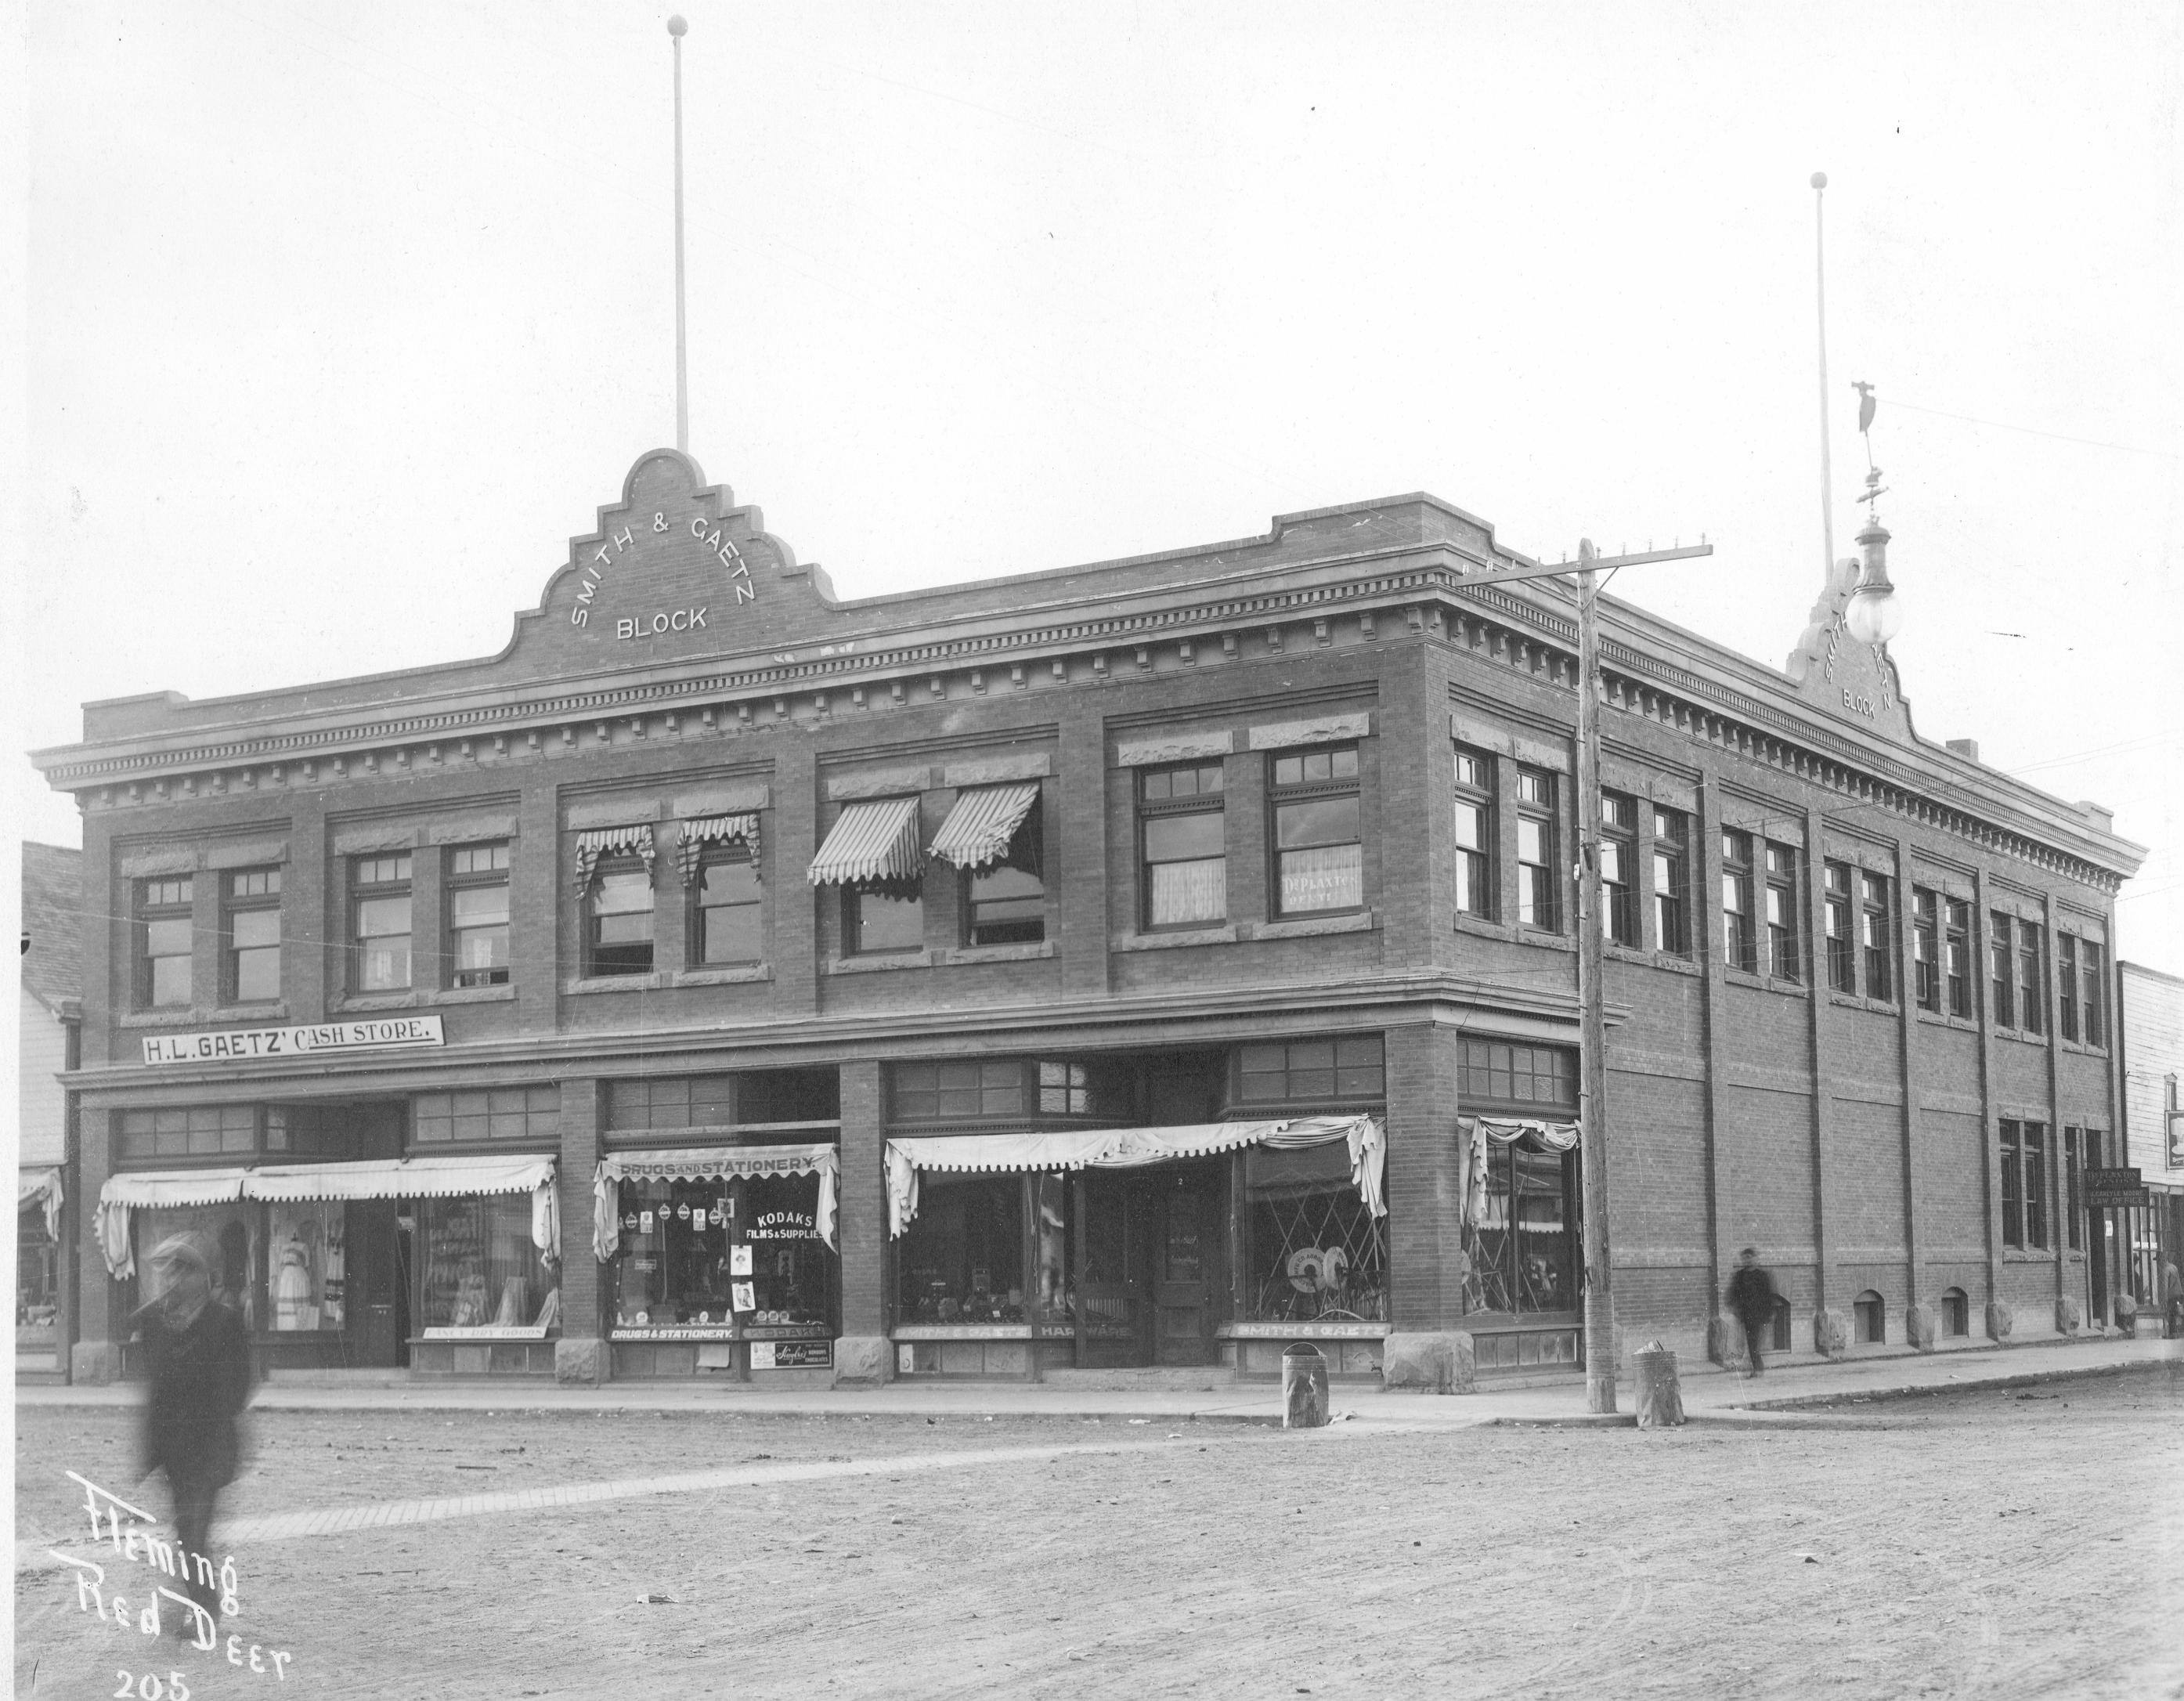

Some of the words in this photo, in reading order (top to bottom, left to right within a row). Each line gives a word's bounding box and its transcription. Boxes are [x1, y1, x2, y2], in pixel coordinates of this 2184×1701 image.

[571, 526, 634, 627] SMITH
[653, 512, 669, 533] &
[691, 518, 756, 605] GAETZ
[617, 608, 707, 640] BLOCK
[1872, 643, 1892, 711] AETZ
[1843, 688, 1875, 720] BLOCK
[294, 1027, 344, 1051] CASH
[354, 1020, 431, 1042] STORE.
[620, 1164, 676, 1175] DRUGS
[676, 1164, 700, 1173] AND
[757, 1212, 812, 1228] KODAKS
[502, 1327, 543, 1336] GOODS
[1237, 1326, 1297, 1336] SMITH
[1302, 1326, 1314, 1336] &
[1320, 1325, 1385, 1335] GAETZ
